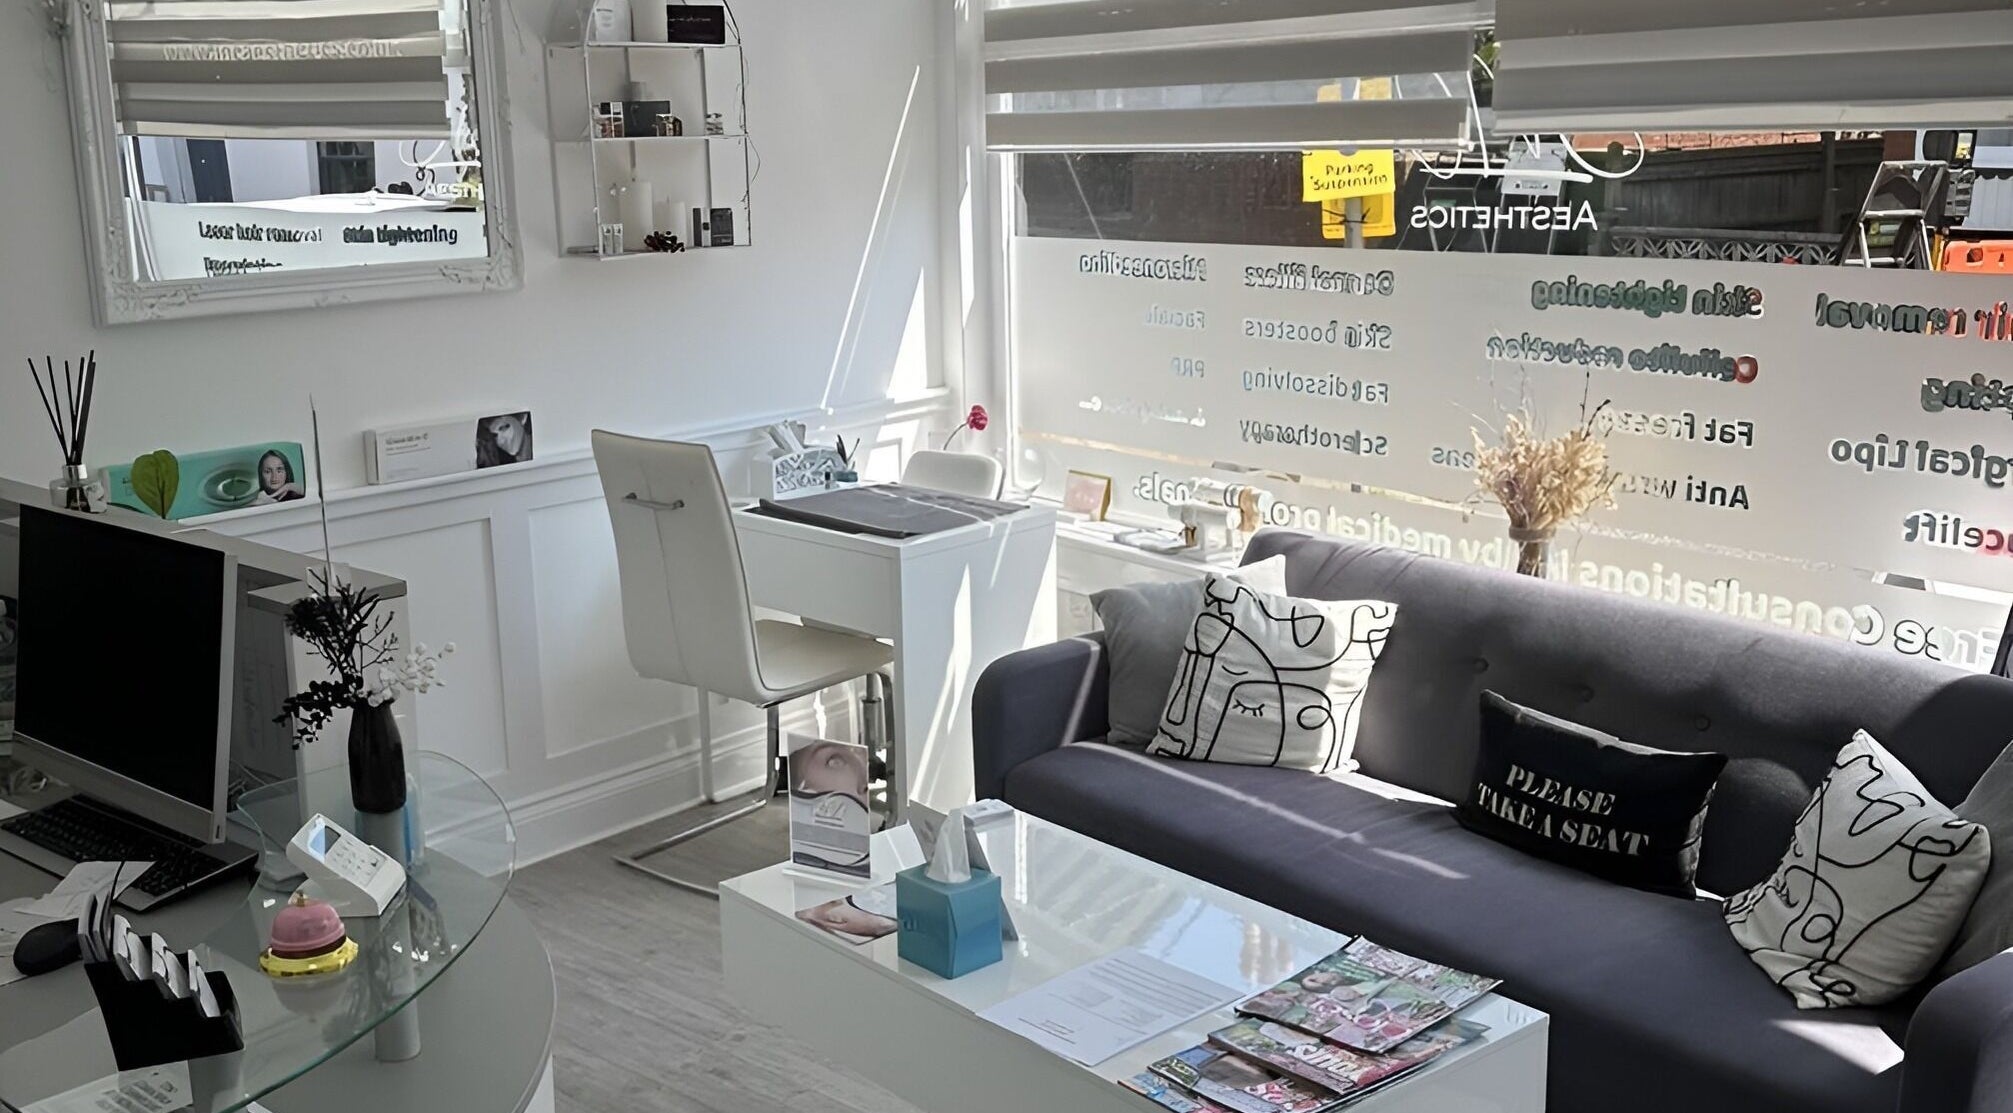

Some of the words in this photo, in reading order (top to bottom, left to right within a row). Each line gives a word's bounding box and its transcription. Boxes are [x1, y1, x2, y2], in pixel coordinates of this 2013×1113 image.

[1477, 782, 1537, 830] TAKE
[1539, 814, 1553, 839] A
[1559, 818, 1650, 857] SEAT
[1505, 764, 1616, 816] PLEASE
